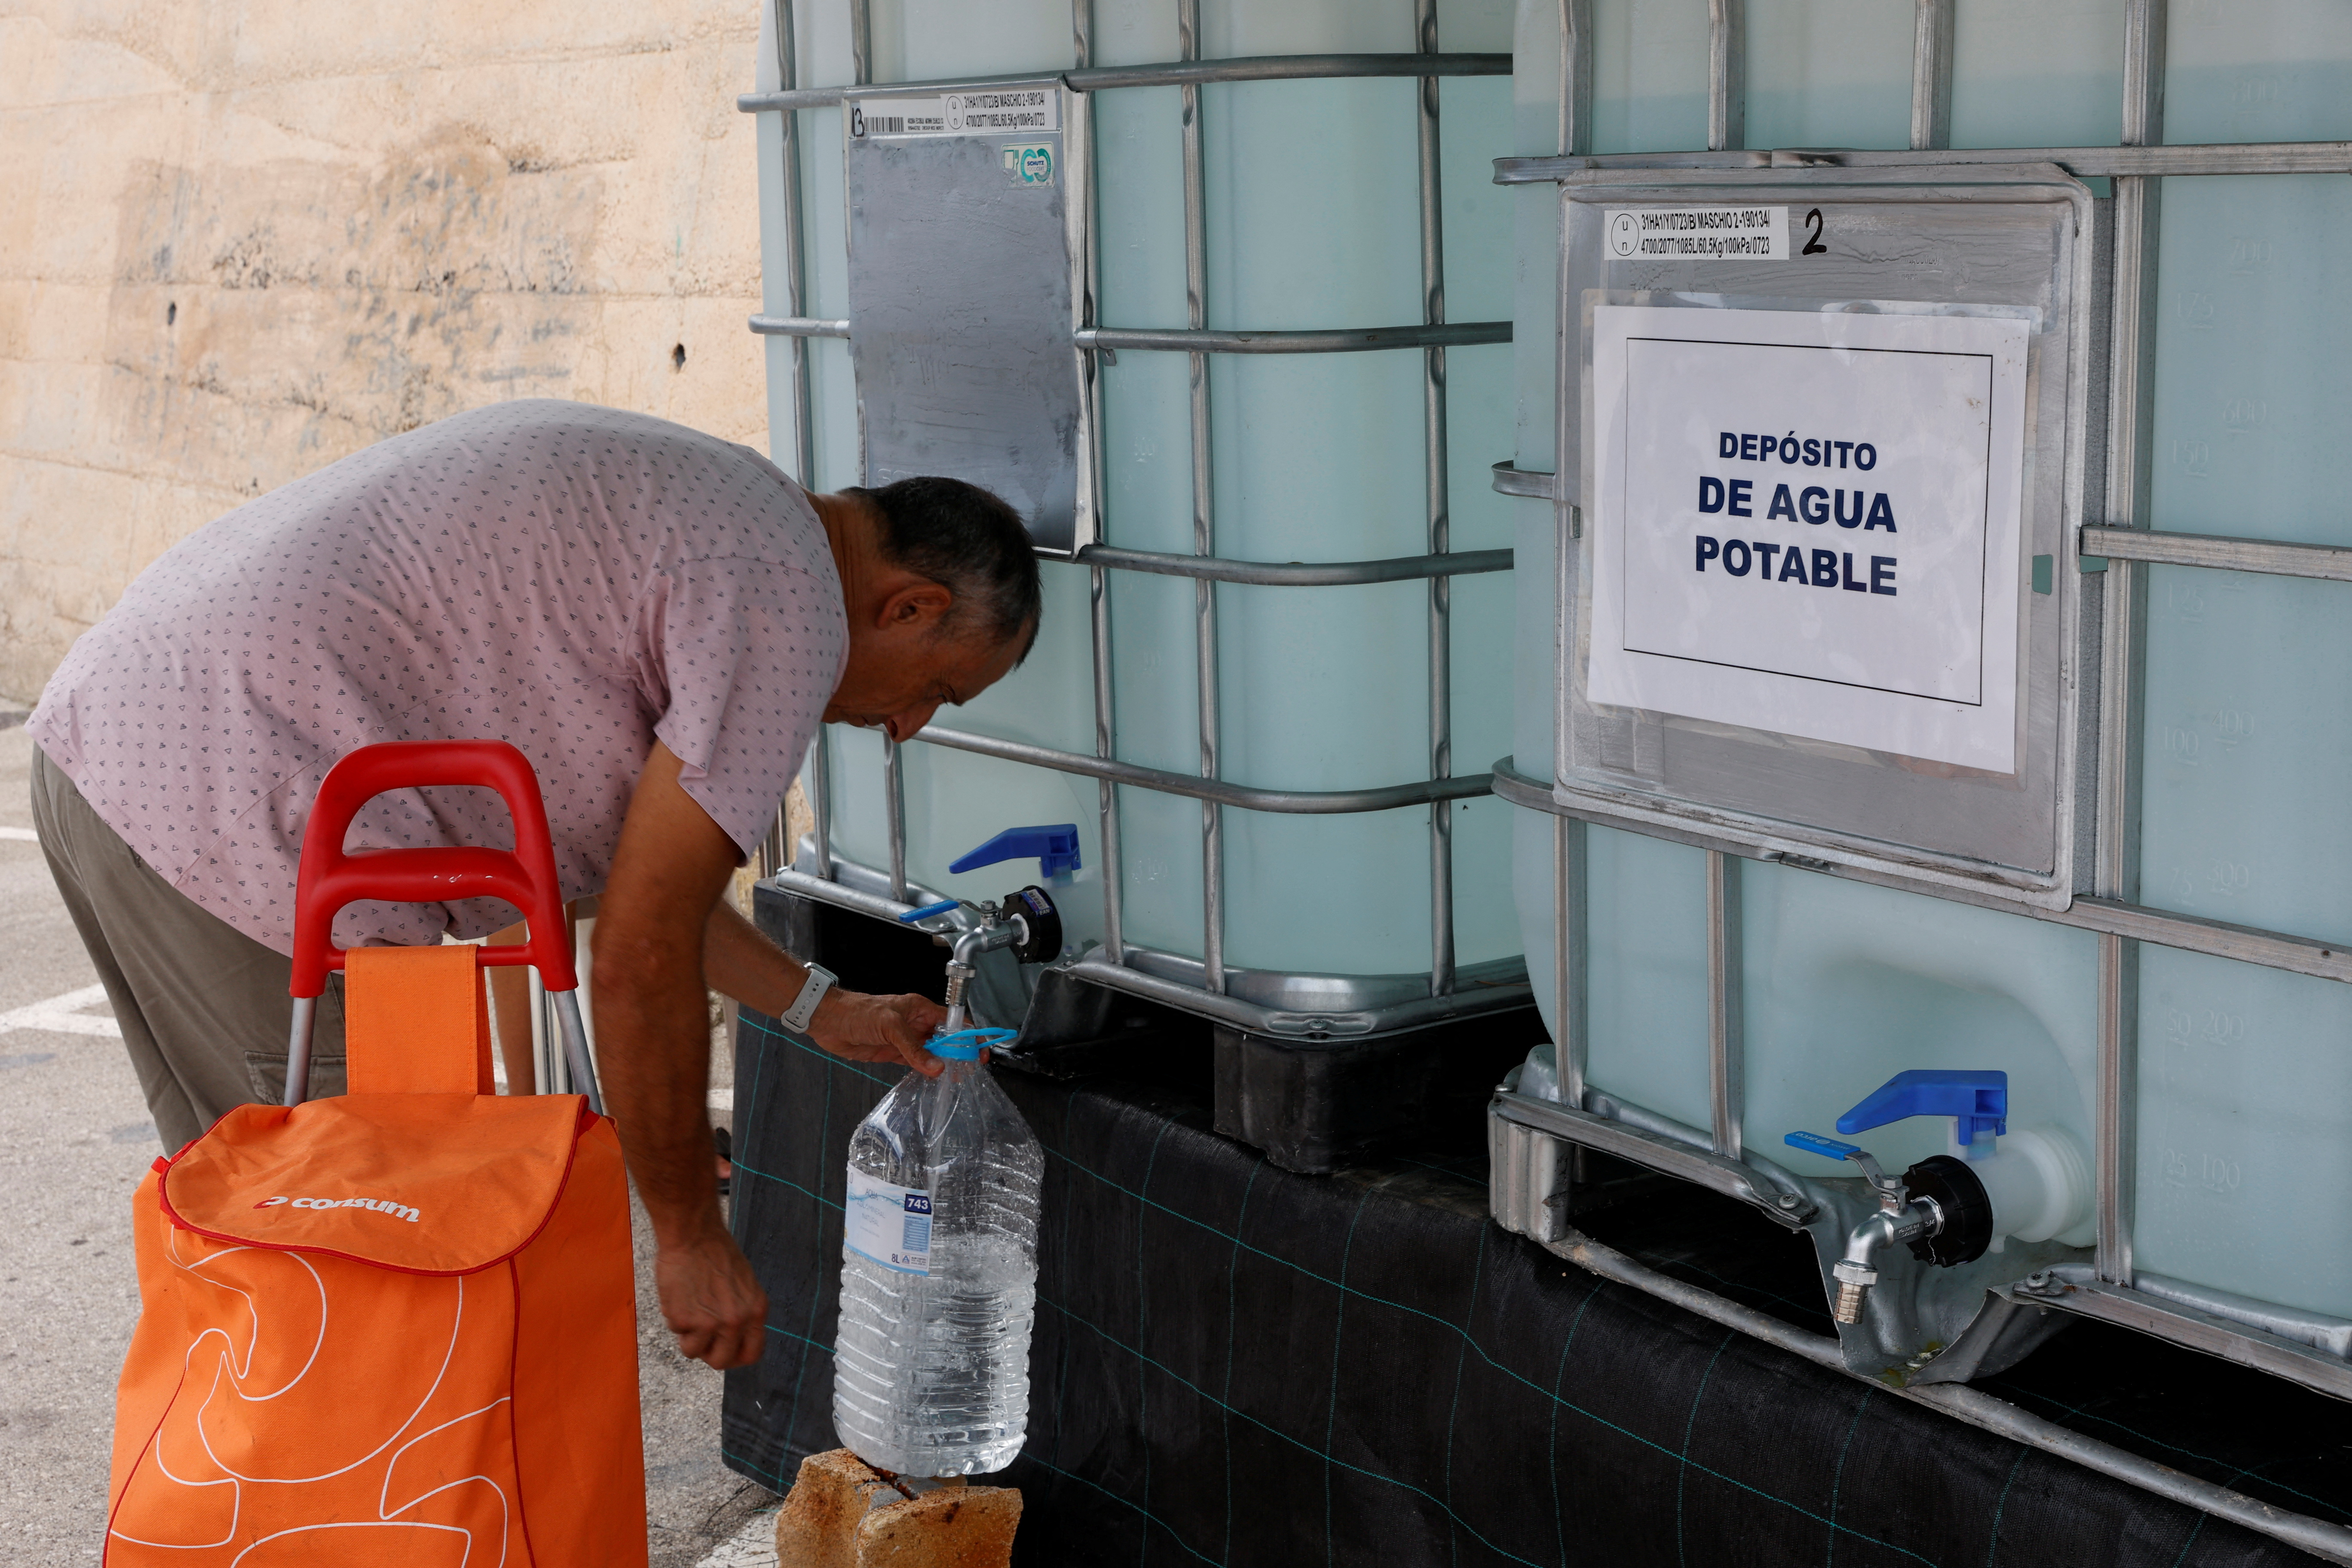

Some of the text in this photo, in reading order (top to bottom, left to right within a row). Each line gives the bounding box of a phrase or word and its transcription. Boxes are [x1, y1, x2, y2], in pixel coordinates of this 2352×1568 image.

[999, 93, 1022, 107] MASCHIO
[1697, 211, 1733, 229] MASCHIO
[1802, 208, 1827, 255] 2
[1641, 236, 1770, 258] 4700/2077/1085L/60,5Kg/100kPa/0723
[2177, 292, 2214, 318] 175
[291, 337, 420, 363] consum
[2222, 398, 2267, 426] 600
[1719, 431, 1877, 471] DEPÓSITO
[2172, 439, 2208, 468] 150
[1699, 476, 1897, 533] DE AGUA
[1696, 536, 1897, 596] POTABLE
[2212, 709, 2254, 735] 400
[2164, 726, 2199, 756] 100
[2166, 1008, 2244, 1040] 50 200
[1796, 1133, 1818, 1141] arco
[2202, 1153, 2240, 1189] 100
[908, 1198, 928, 1210] 743
[892, 1253, 900, 1264] 8L
